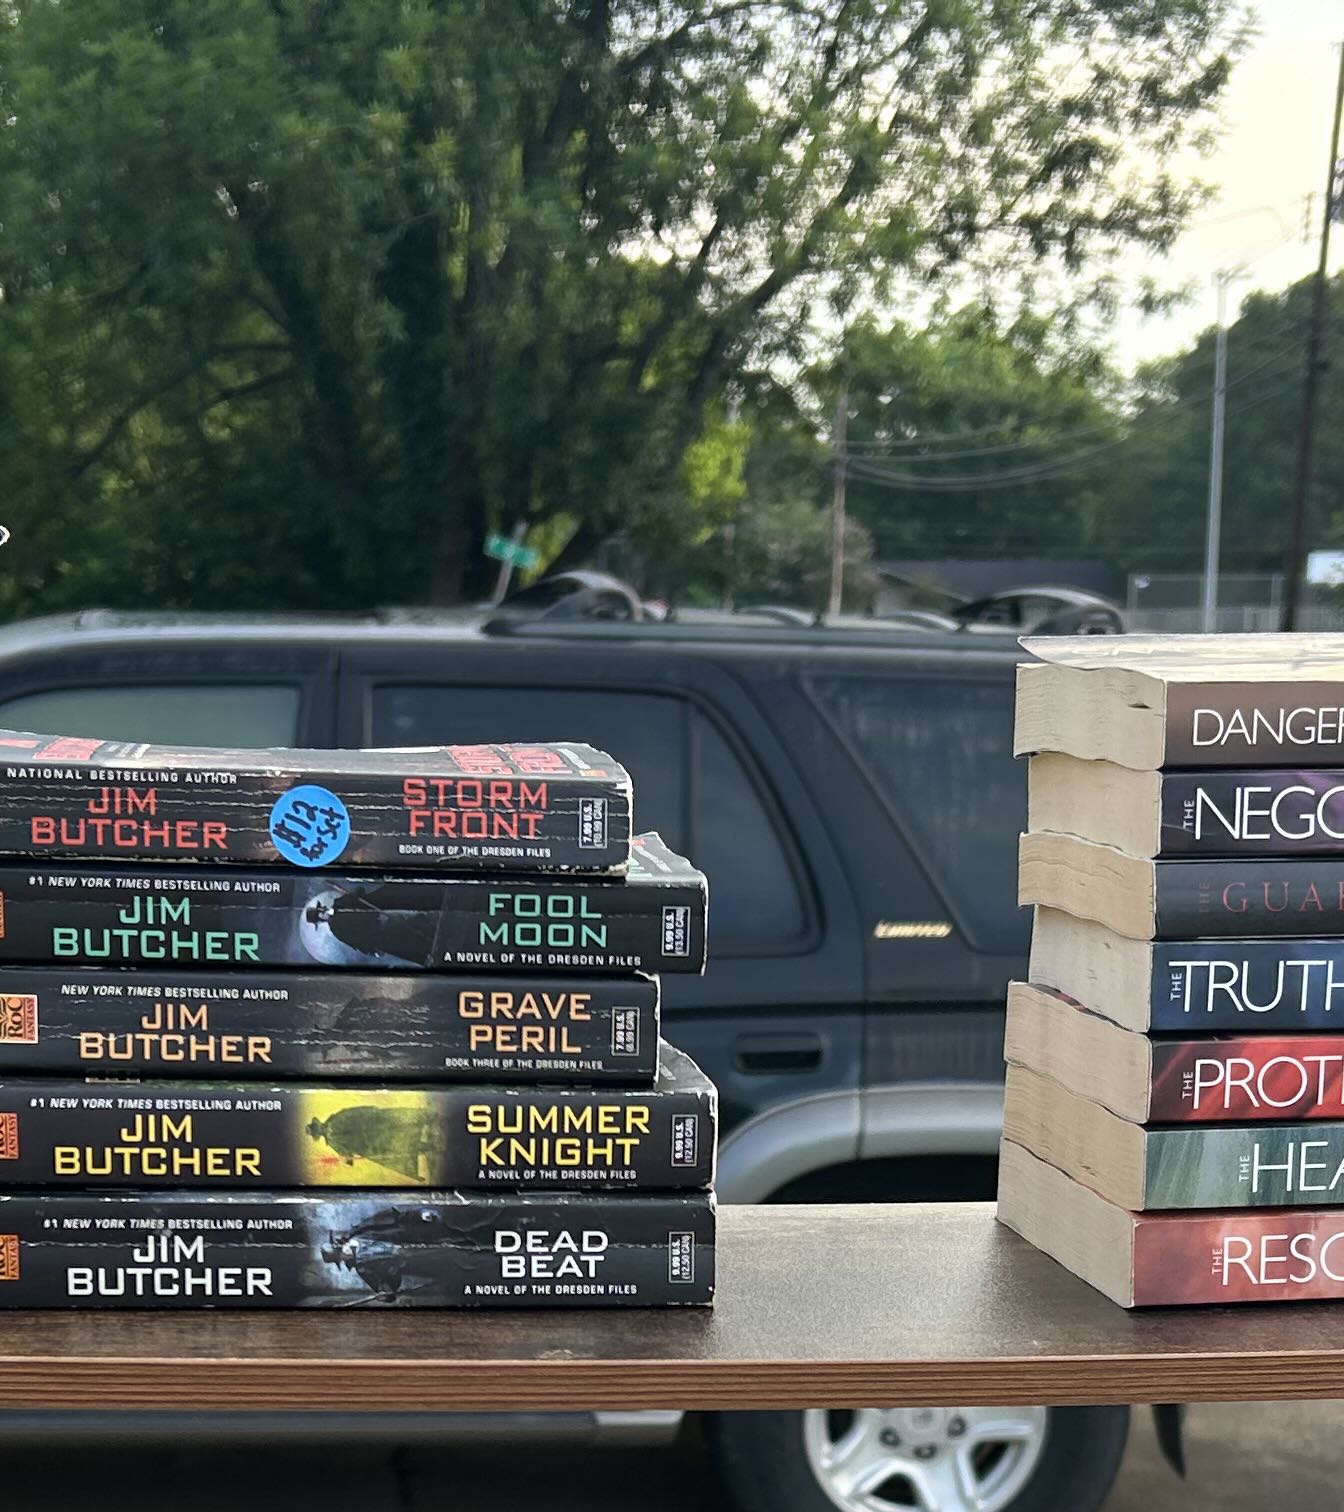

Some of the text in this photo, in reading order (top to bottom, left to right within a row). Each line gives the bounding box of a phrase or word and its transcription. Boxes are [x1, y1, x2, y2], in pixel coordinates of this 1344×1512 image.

[7, 766, 238, 785] NATIONAL BESTSELLING AUTHOR
[87, 786, 157, 816] JIM
[403, 778, 549, 810] STORM
[30, 816, 229, 850] BUTCHER
[409, 811, 545, 839] FRONT
[488, 893, 603, 919] FOOL
[479, 921, 607, 949] MOON
[459, 990, 593, 1021] GRAVE
[469, 1024, 582, 1054] PERIL
[466, 1104, 651, 1135] SUMMER
[480, 1137, 640, 1167] KNIGHT
[495, 1230, 609, 1254] DEAD
[501, 1254, 605, 1279] BEAT
[464, 1284, 638, 1295] A NOVEL OF THE DRESDEN FILES
